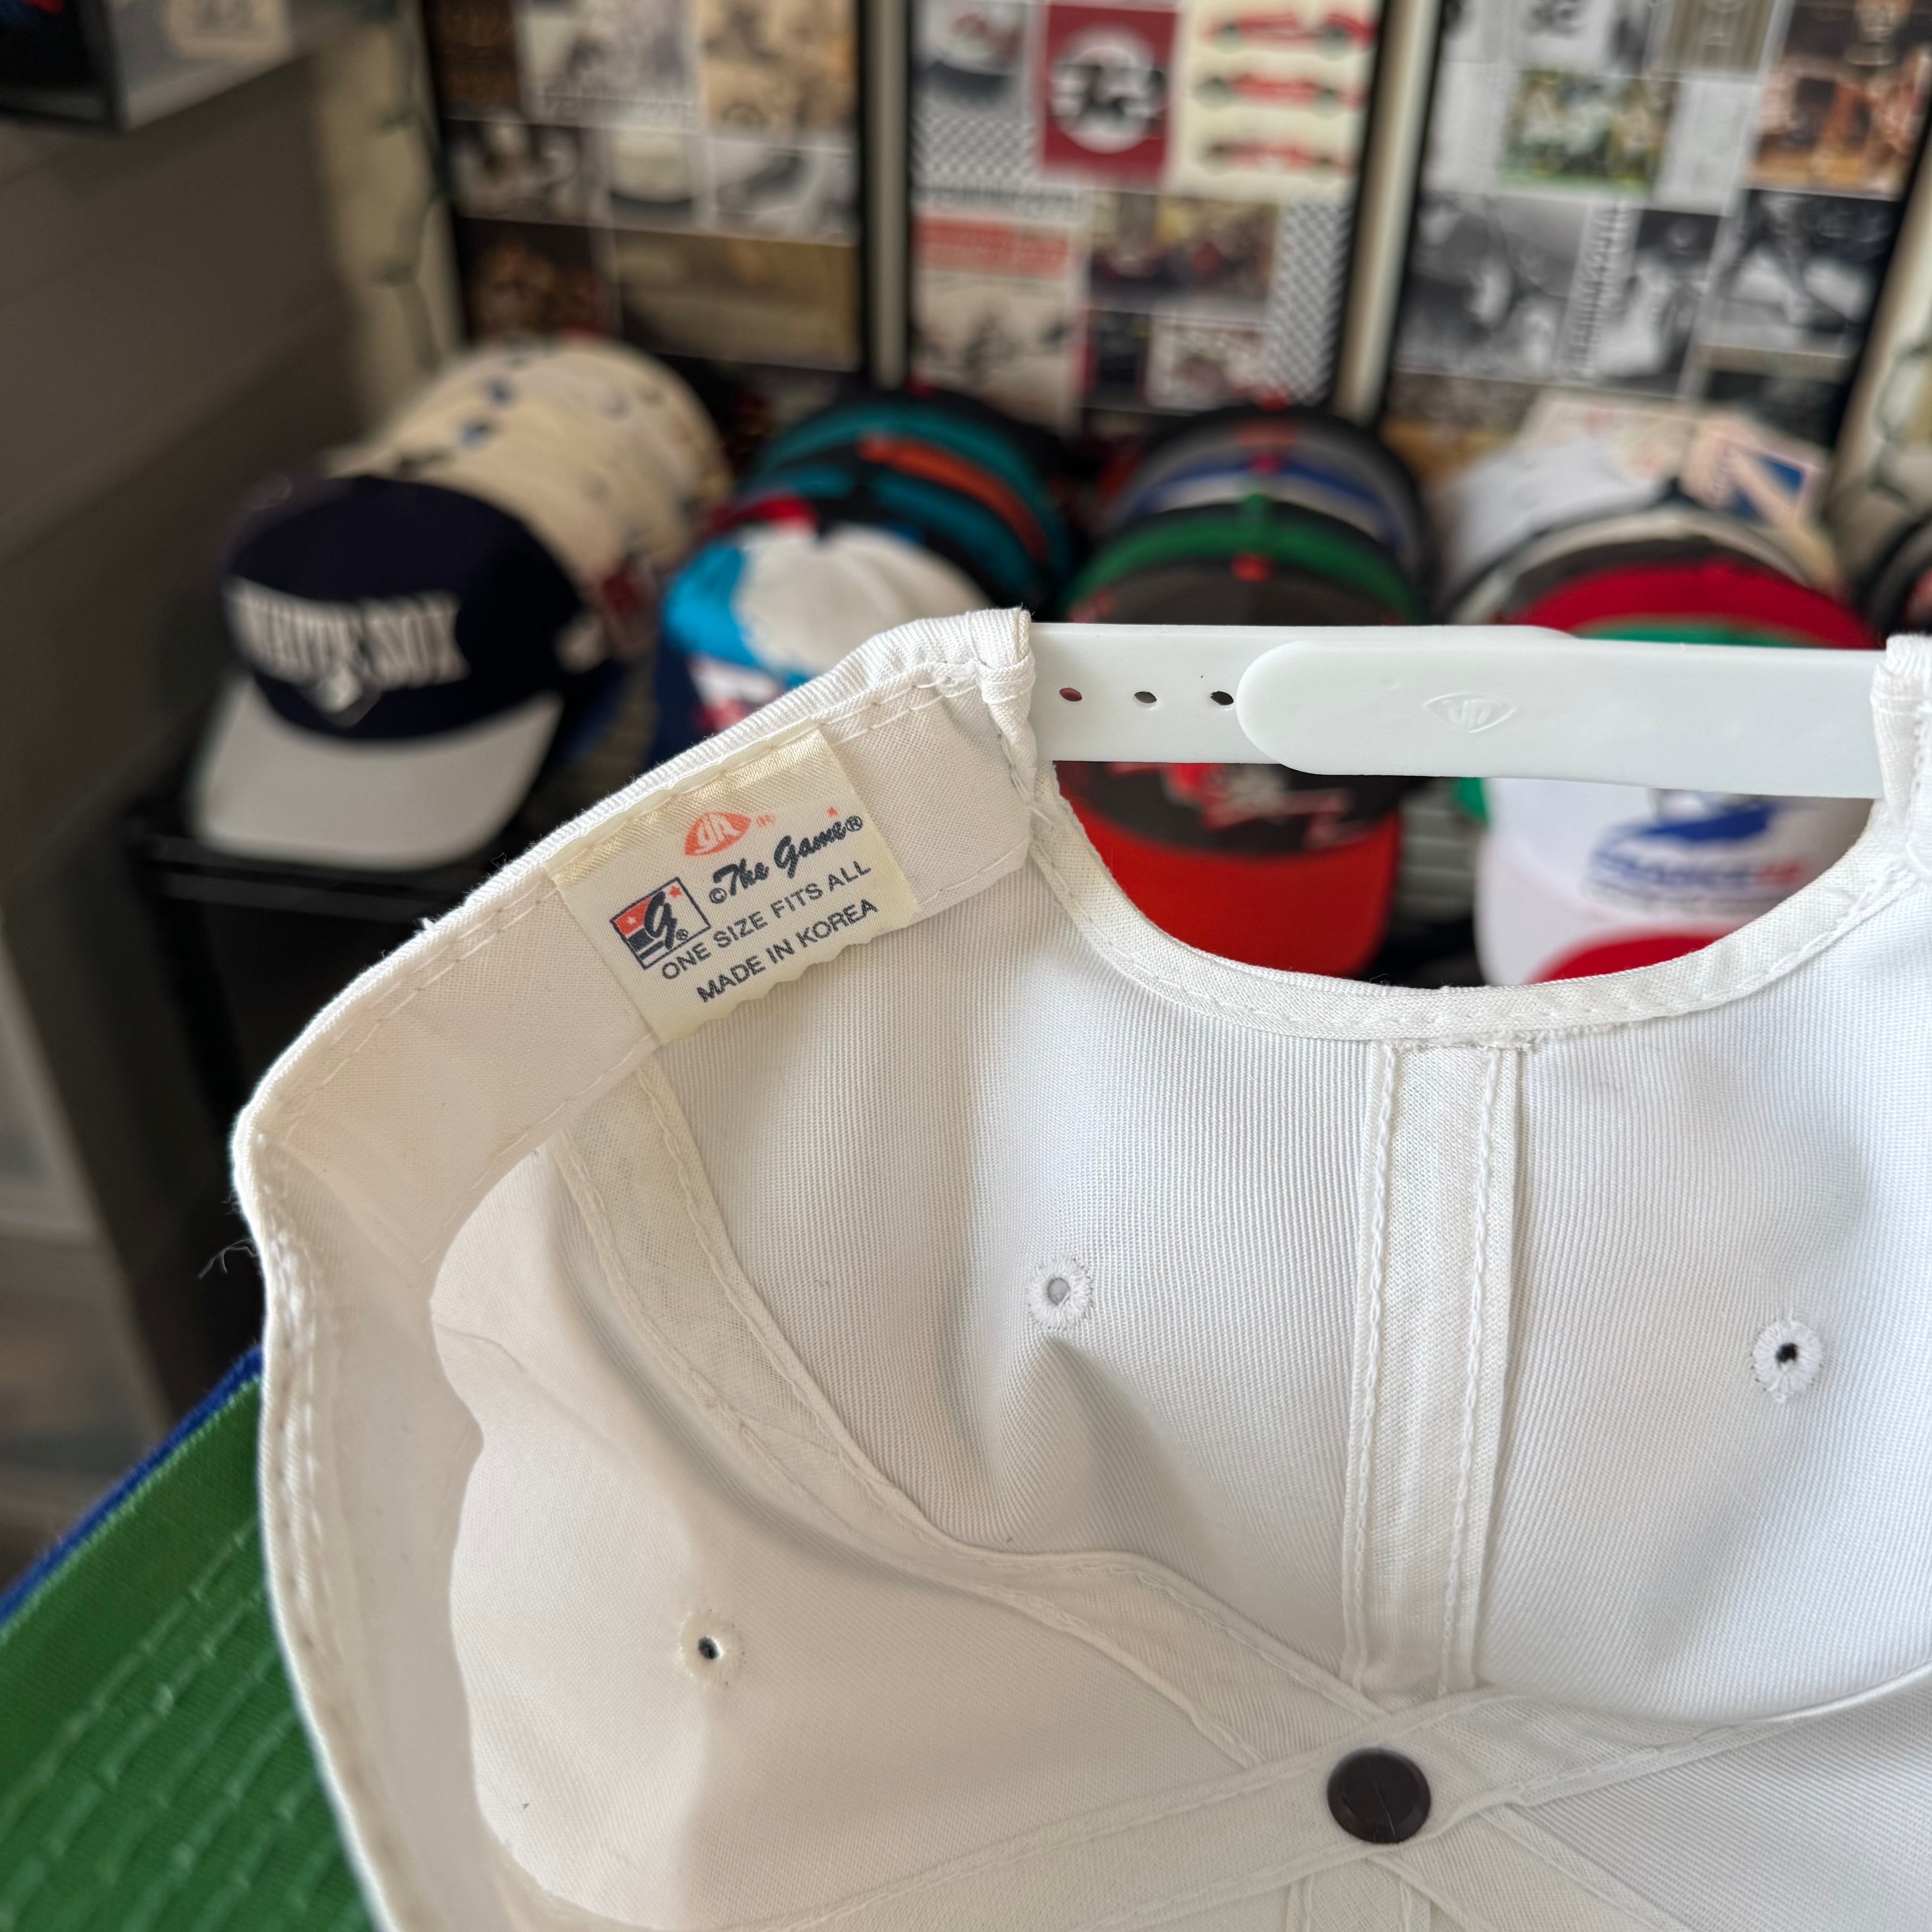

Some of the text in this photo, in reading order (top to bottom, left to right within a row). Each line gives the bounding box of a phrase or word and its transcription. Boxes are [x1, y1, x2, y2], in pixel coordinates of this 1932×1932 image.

[661, 860, 871, 980] ONE SIZE FITS ALL
[697, 898, 879, 1003] MADE IN KOREA
